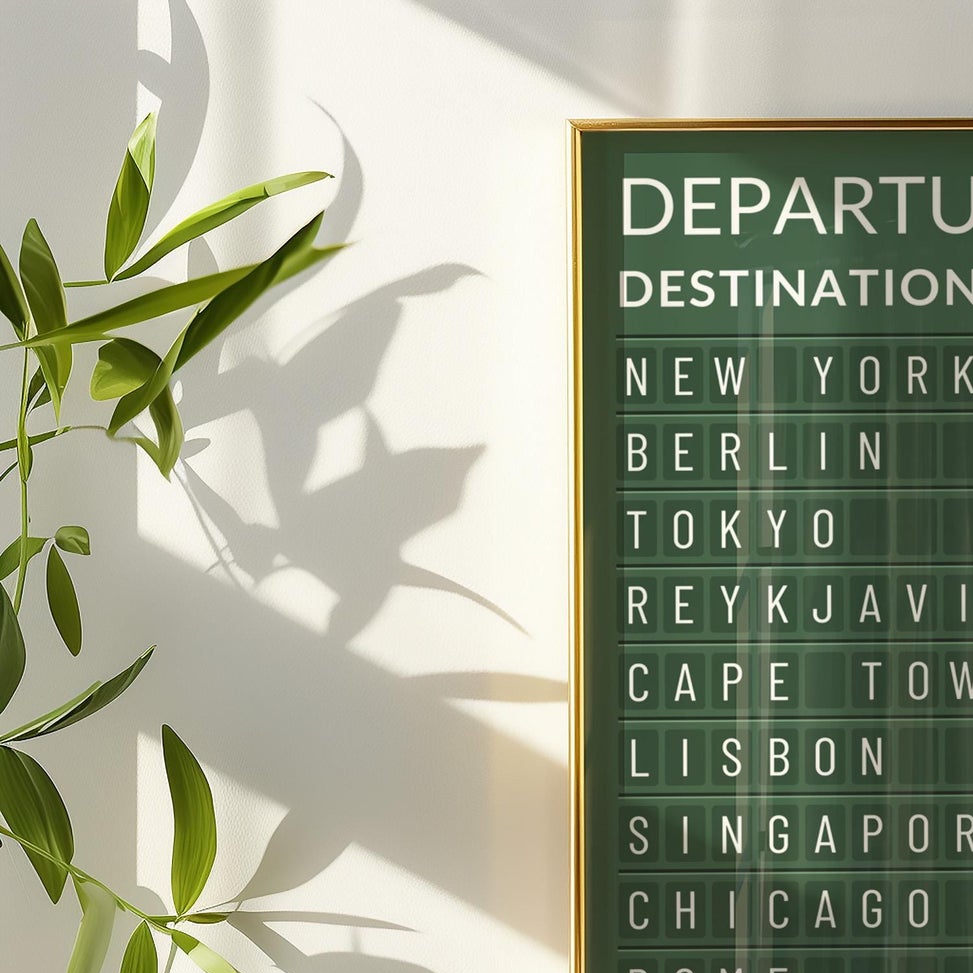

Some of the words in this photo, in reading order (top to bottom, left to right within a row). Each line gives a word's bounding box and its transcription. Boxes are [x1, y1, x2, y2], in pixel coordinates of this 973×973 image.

[626, 357, 745, 396] NEW
[628, 432, 880, 471] BERLIN
[627, 509, 833, 549] TOKYO
[629, 663, 788, 702] CAPE
[631, 737, 882, 777] LISBON
[629, 889, 928, 930] CHICAGO
